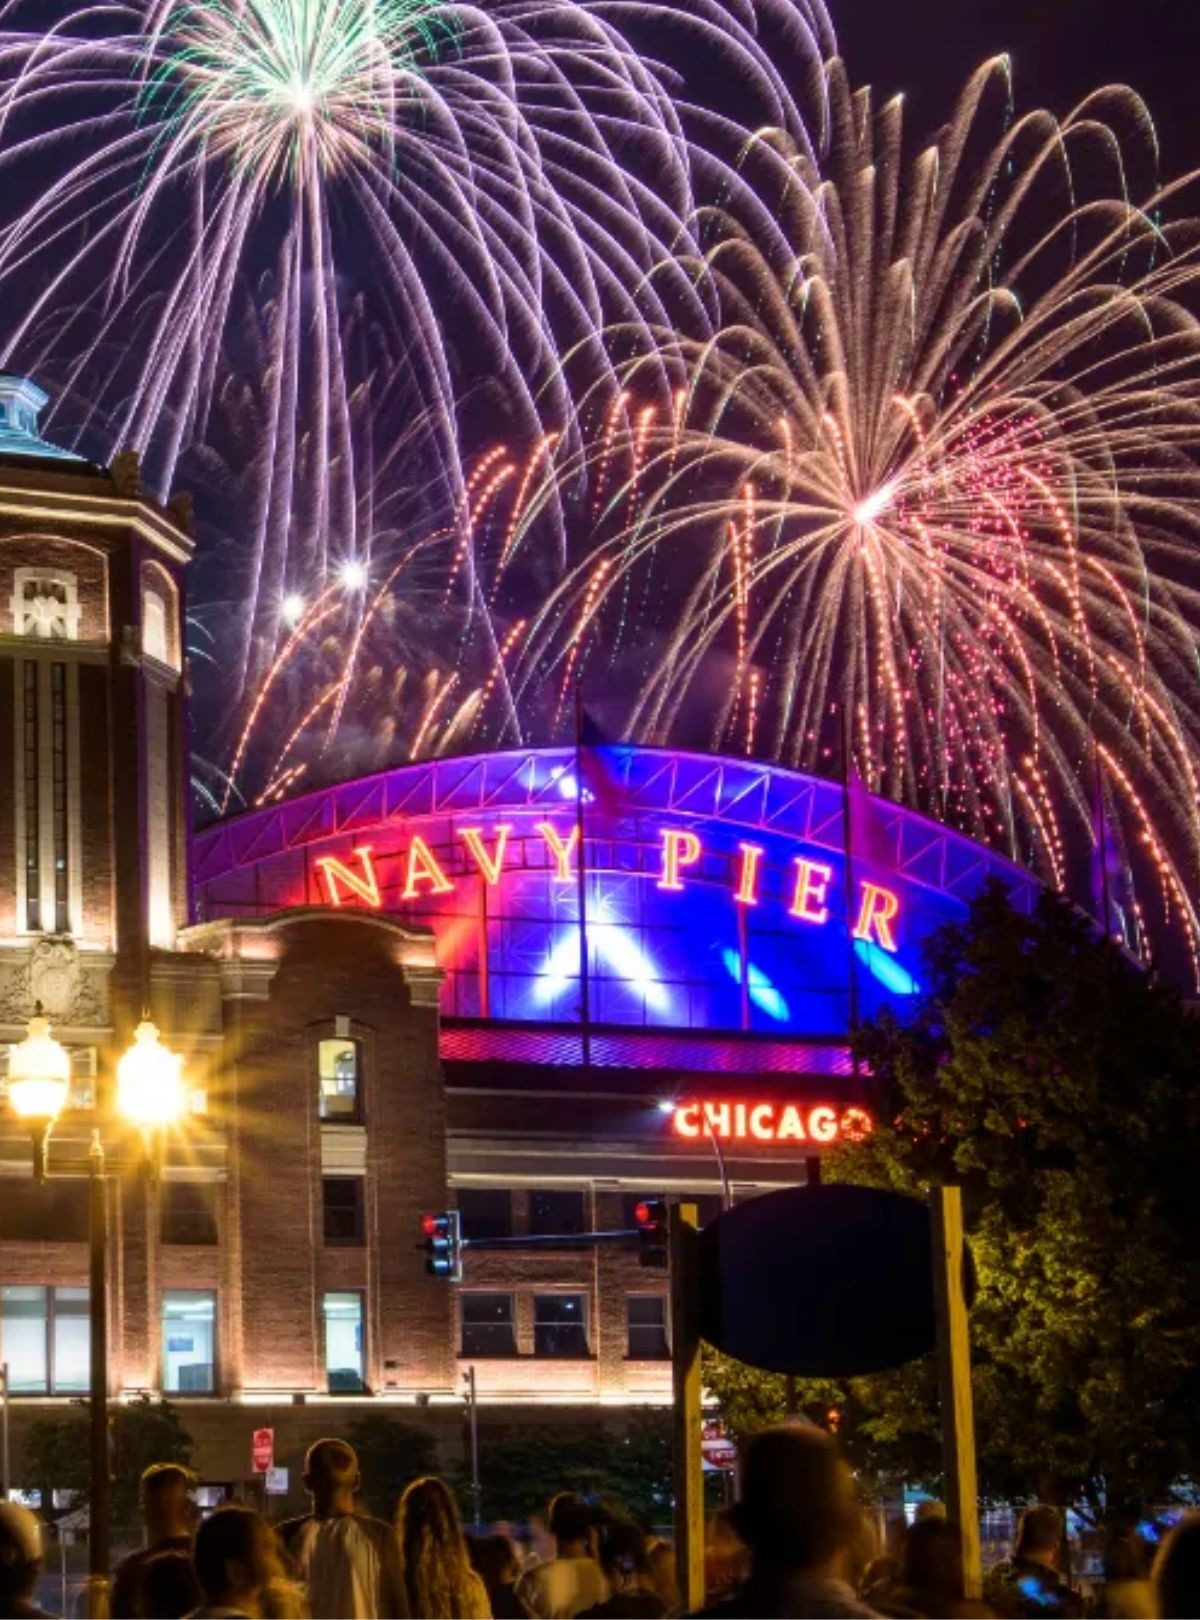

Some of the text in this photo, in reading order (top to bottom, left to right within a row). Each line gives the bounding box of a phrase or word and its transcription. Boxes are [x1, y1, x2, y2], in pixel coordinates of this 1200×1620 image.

[315, 821, 898, 952] NAVY PIER
[674, 1102, 872, 1142] CHICAGO
